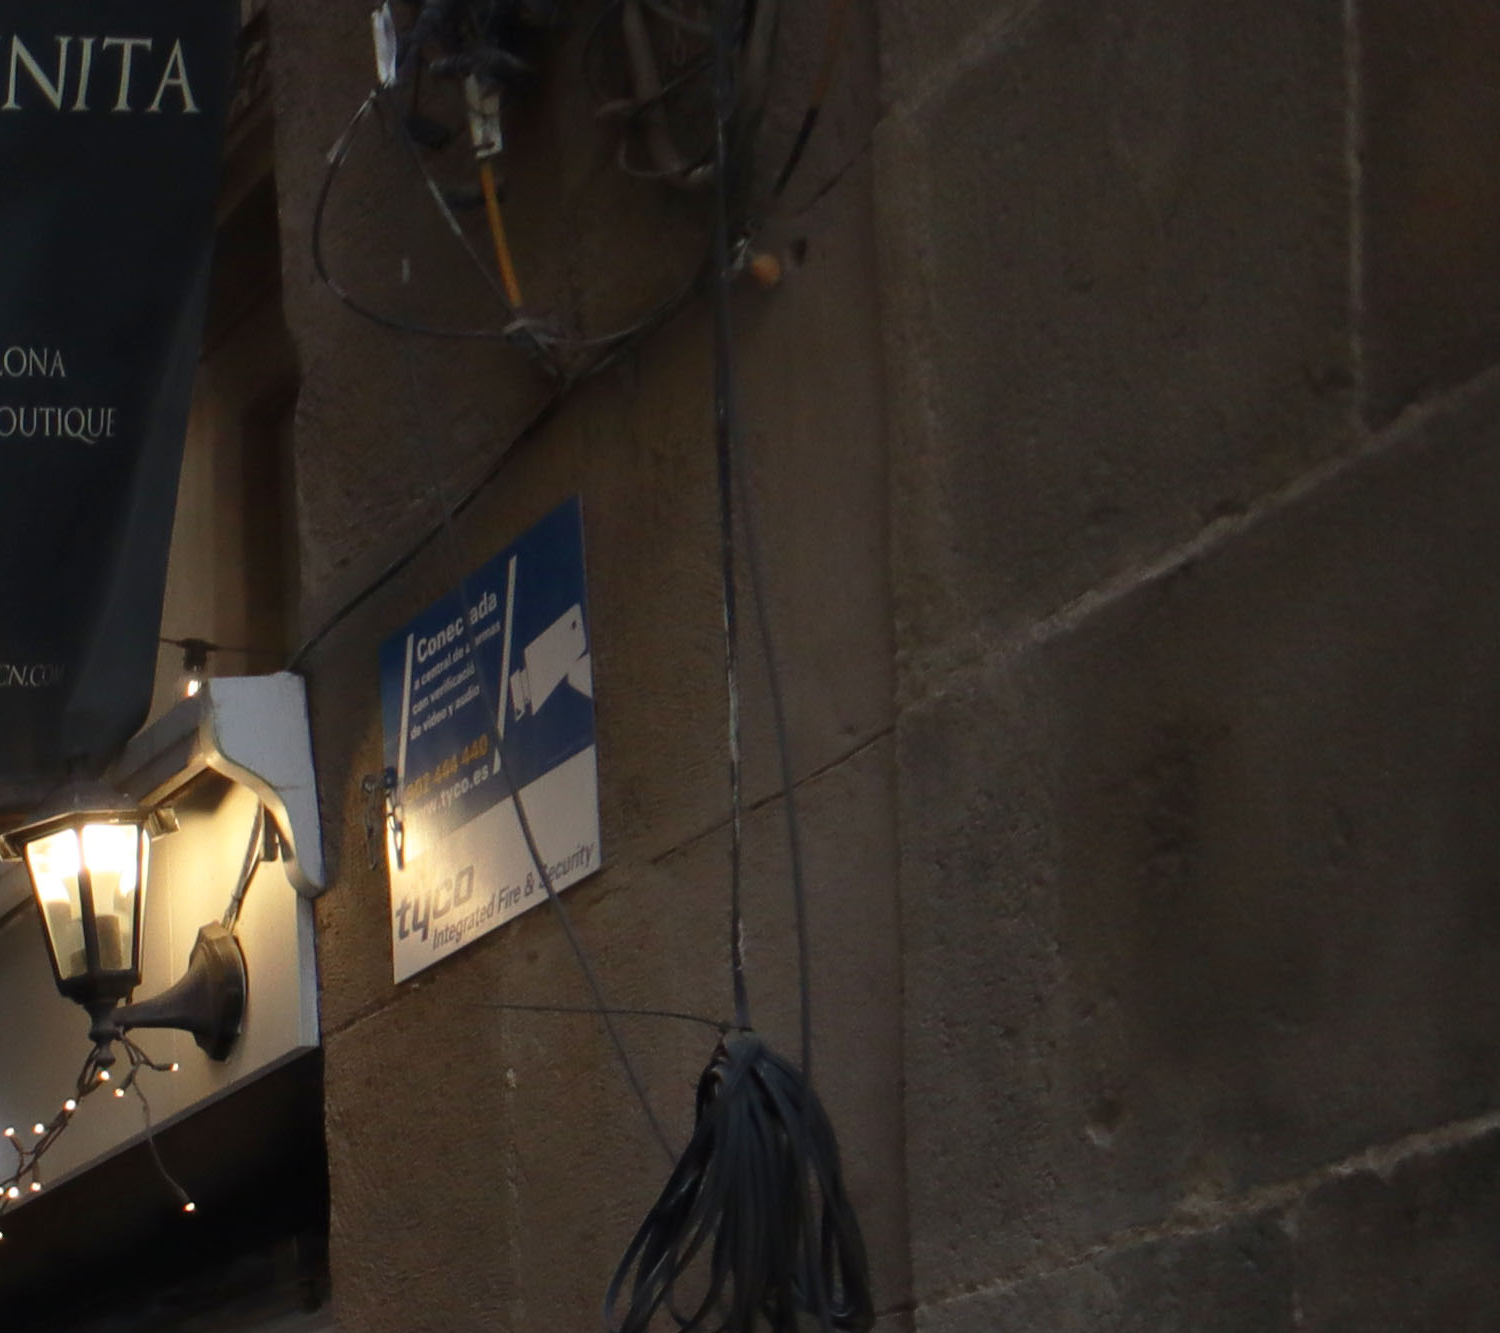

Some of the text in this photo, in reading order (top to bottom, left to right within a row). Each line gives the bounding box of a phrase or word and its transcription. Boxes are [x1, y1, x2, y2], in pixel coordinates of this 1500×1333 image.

[417, 591, 498, 662] Conecada
[412, 697, 429, 715] con
[396, 865, 474, 941] tyco
[432, 893, 495, 950] Integrated
[499, 879, 521, 912] Fire
[524, 872, 535, 897] &
